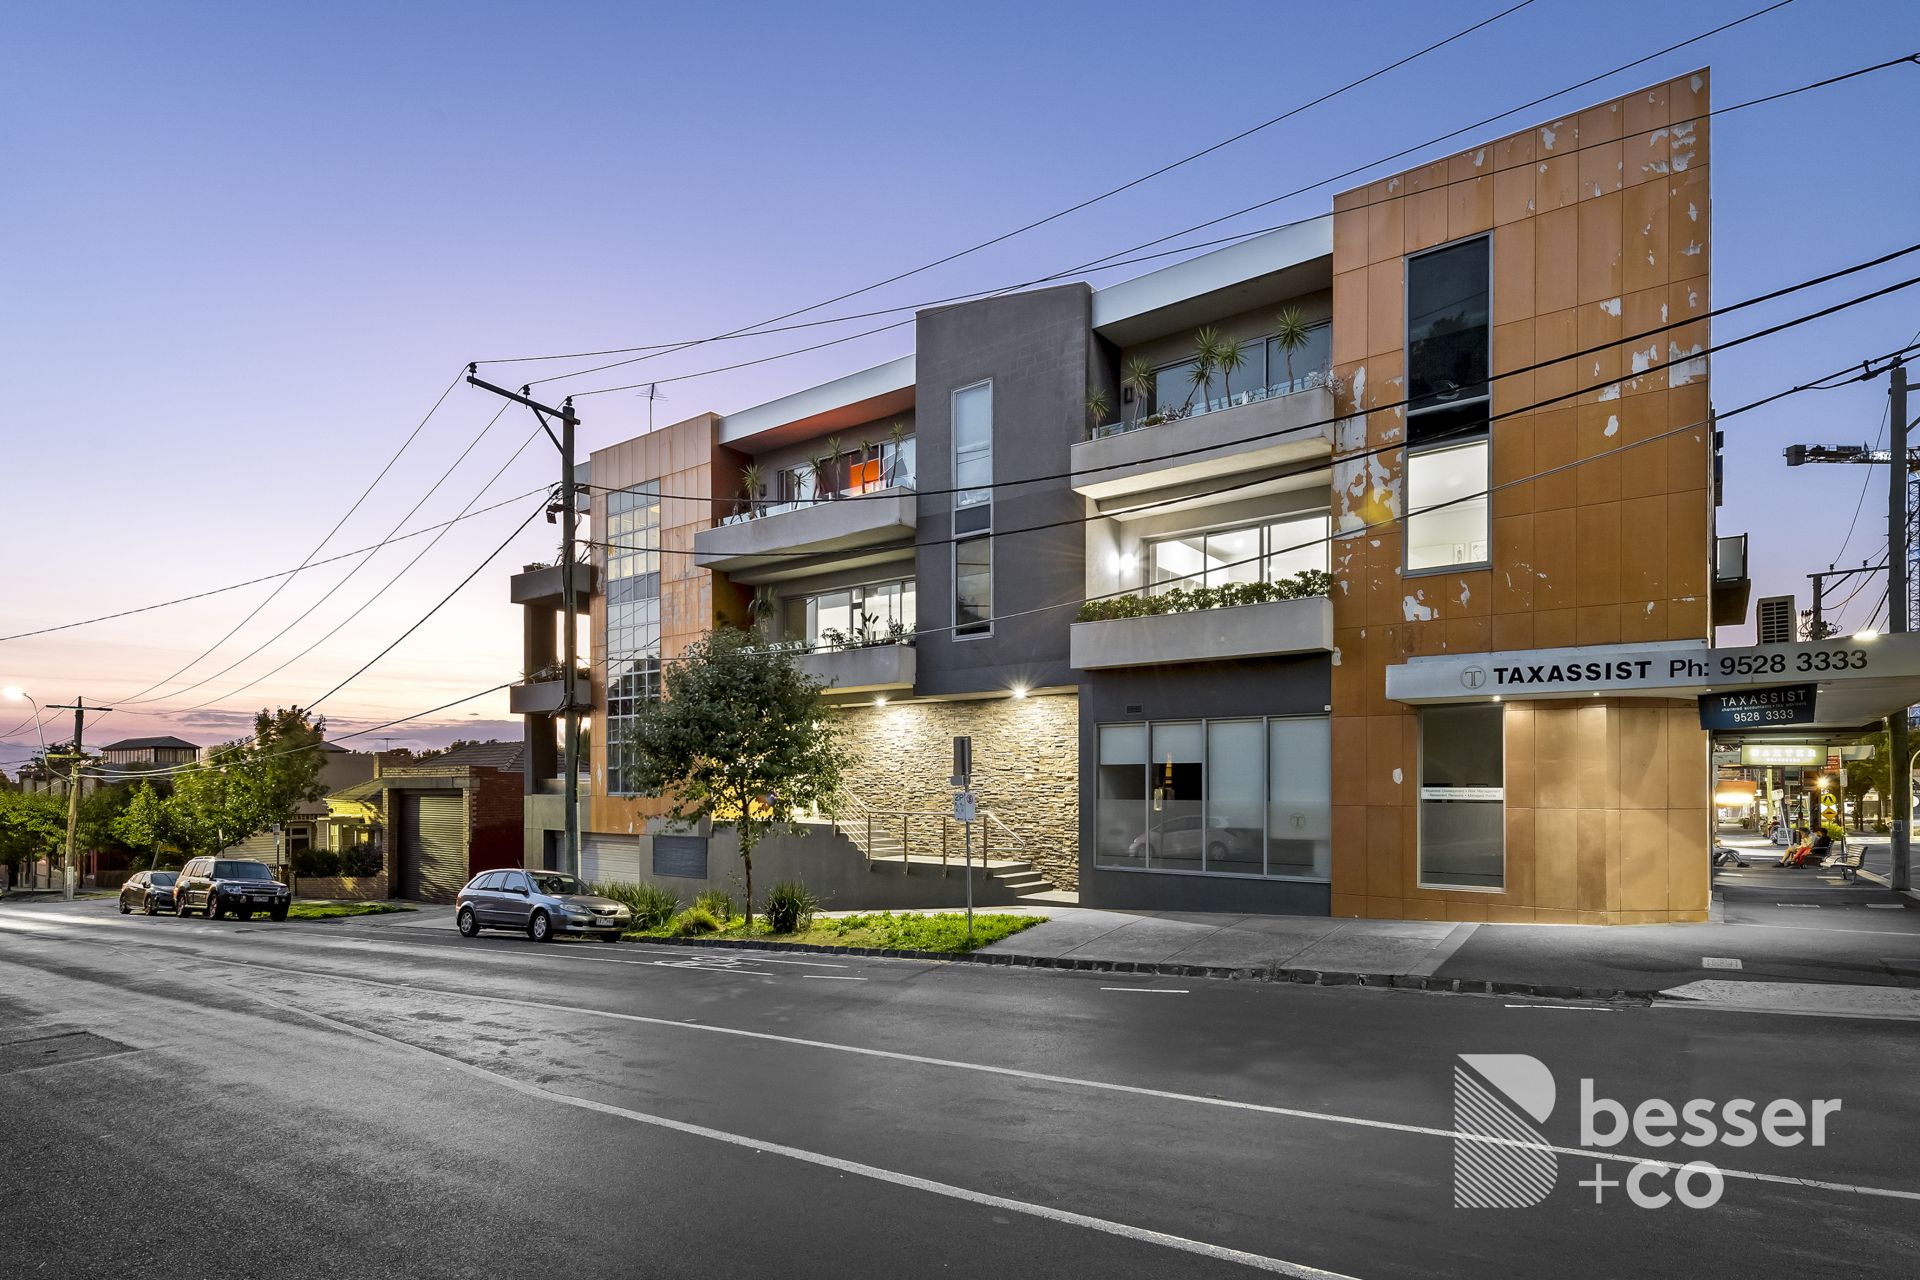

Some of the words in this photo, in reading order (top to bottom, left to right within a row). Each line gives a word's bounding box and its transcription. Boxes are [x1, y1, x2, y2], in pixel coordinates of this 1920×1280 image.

[1493, 661, 1652, 684] TAXASSIST
[1669, 659, 1709, 677] Ph:
[1720, 654, 1786, 676] 9528
[1796, 650, 1868, 672] 3333
[1721, 690, 1806, 706] TAXASSIST
[1734, 712, 1760, 722] 9528
[1765, 709, 1794, 720] 3333
